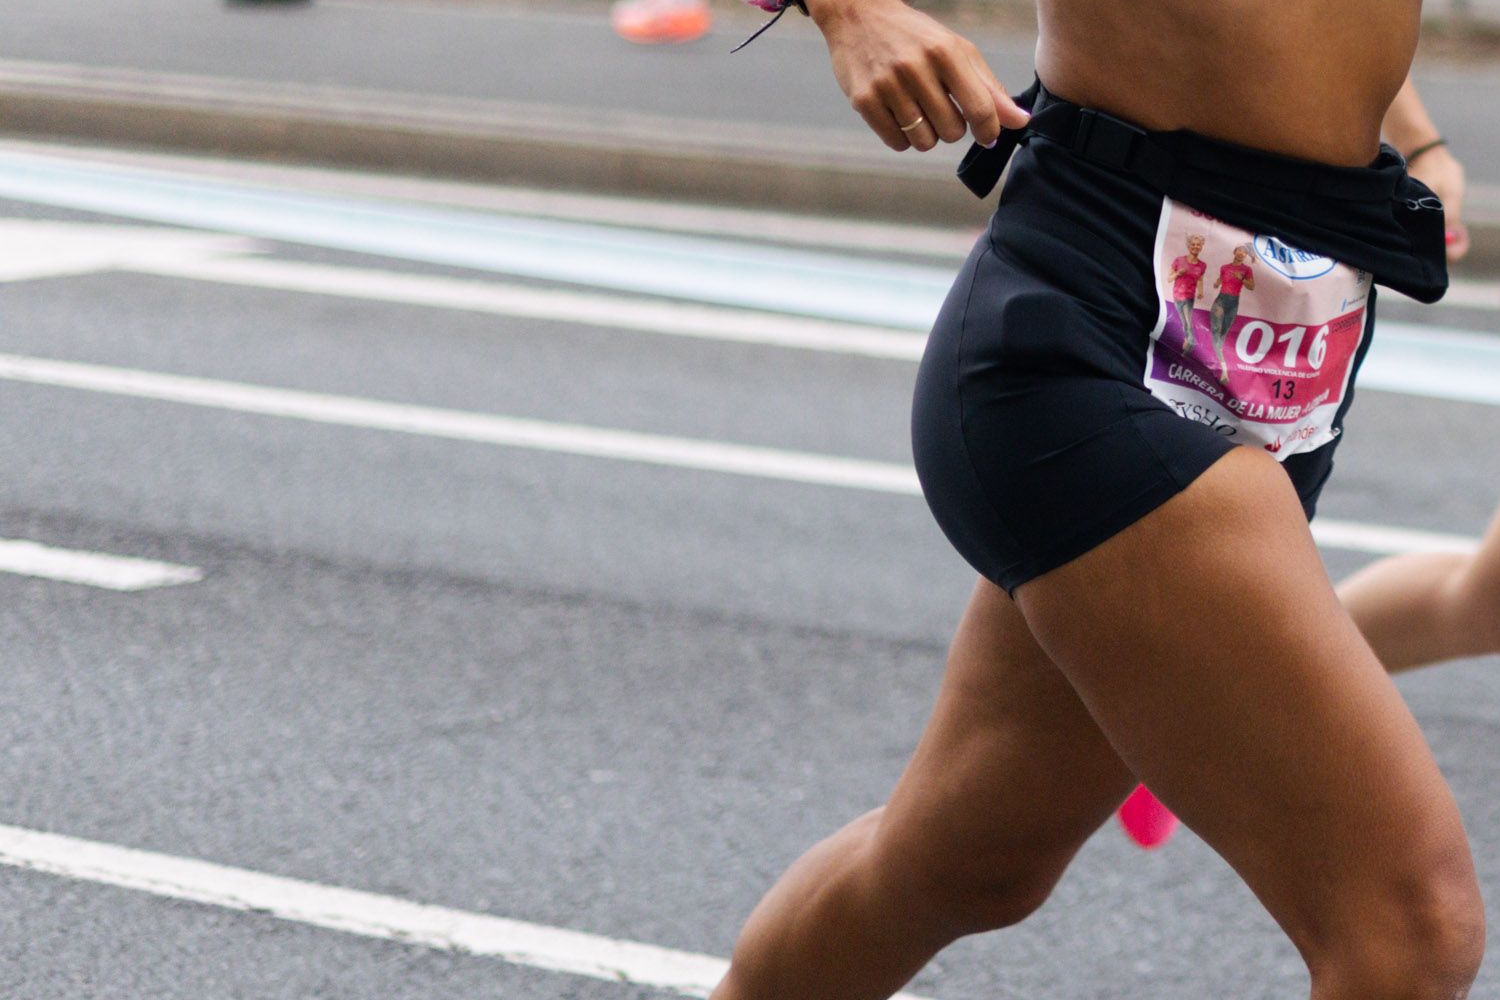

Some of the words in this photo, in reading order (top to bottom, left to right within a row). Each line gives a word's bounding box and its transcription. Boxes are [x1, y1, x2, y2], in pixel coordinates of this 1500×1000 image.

[1234, 320, 1328, 370] 016
[1168, 363, 1225, 401] CARRERA
[1226, 397, 1248, 415] DE
[1246, 402, 1269, 419] LA
[1266, 404, 1302, 420] MUJER
[1272, 378, 1296, 400] 13
